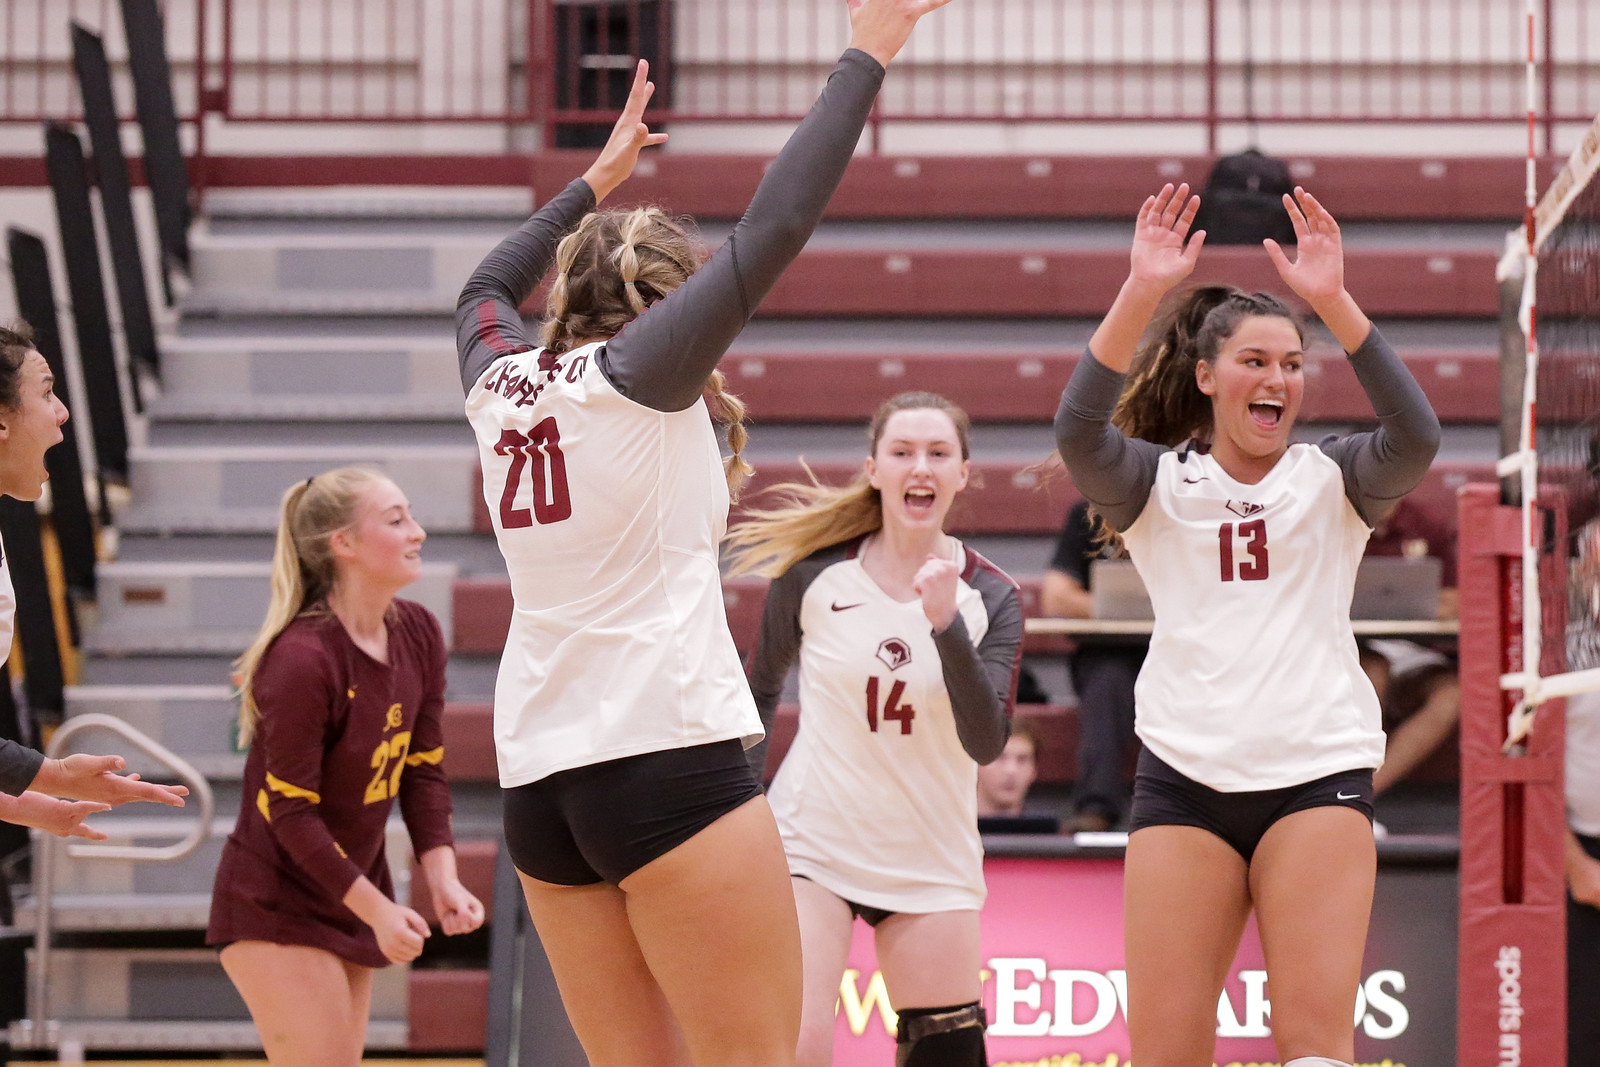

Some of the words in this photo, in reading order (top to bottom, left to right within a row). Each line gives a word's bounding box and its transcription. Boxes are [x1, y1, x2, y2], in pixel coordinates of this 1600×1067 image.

[494, 416, 572, 530] 20
[1218, 518, 1269, 582] 13
[865, 676, 916, 735] 14
[987, 957, 1409, 1039] EDARS
